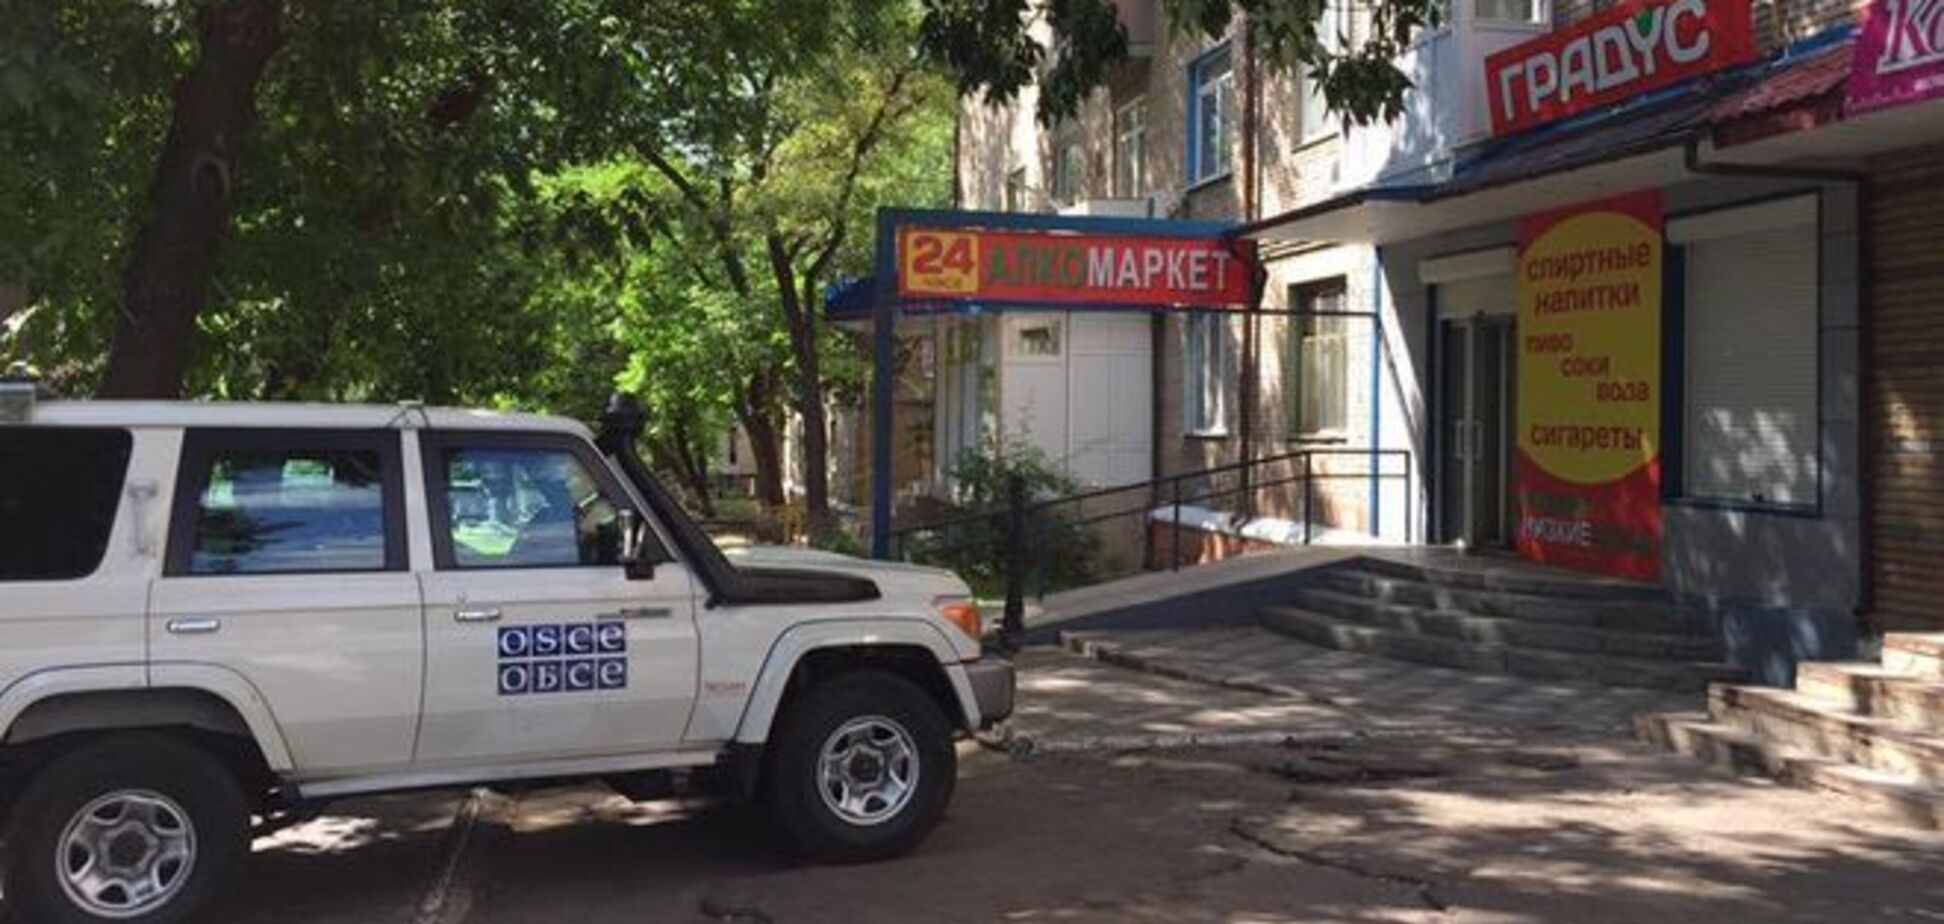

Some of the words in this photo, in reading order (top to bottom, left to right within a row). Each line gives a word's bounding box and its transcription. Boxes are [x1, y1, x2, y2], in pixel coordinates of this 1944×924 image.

[1500, 0, 1710, 122] ГРАДУС
[913, 235, 975, 275] 24
[986, 241, 1231, 291] АЛКОМАРКЕТ
[1528, 241, 1650, 284] спиртные
[1534, 283, 1641, 316] напитки
[1526, 332, 1573, 353] пиво
[1560, 356, 1610, 377] соки
[1596, 381, 1650, 403] вода
[1531, 424, 1643, 451] сигареты
